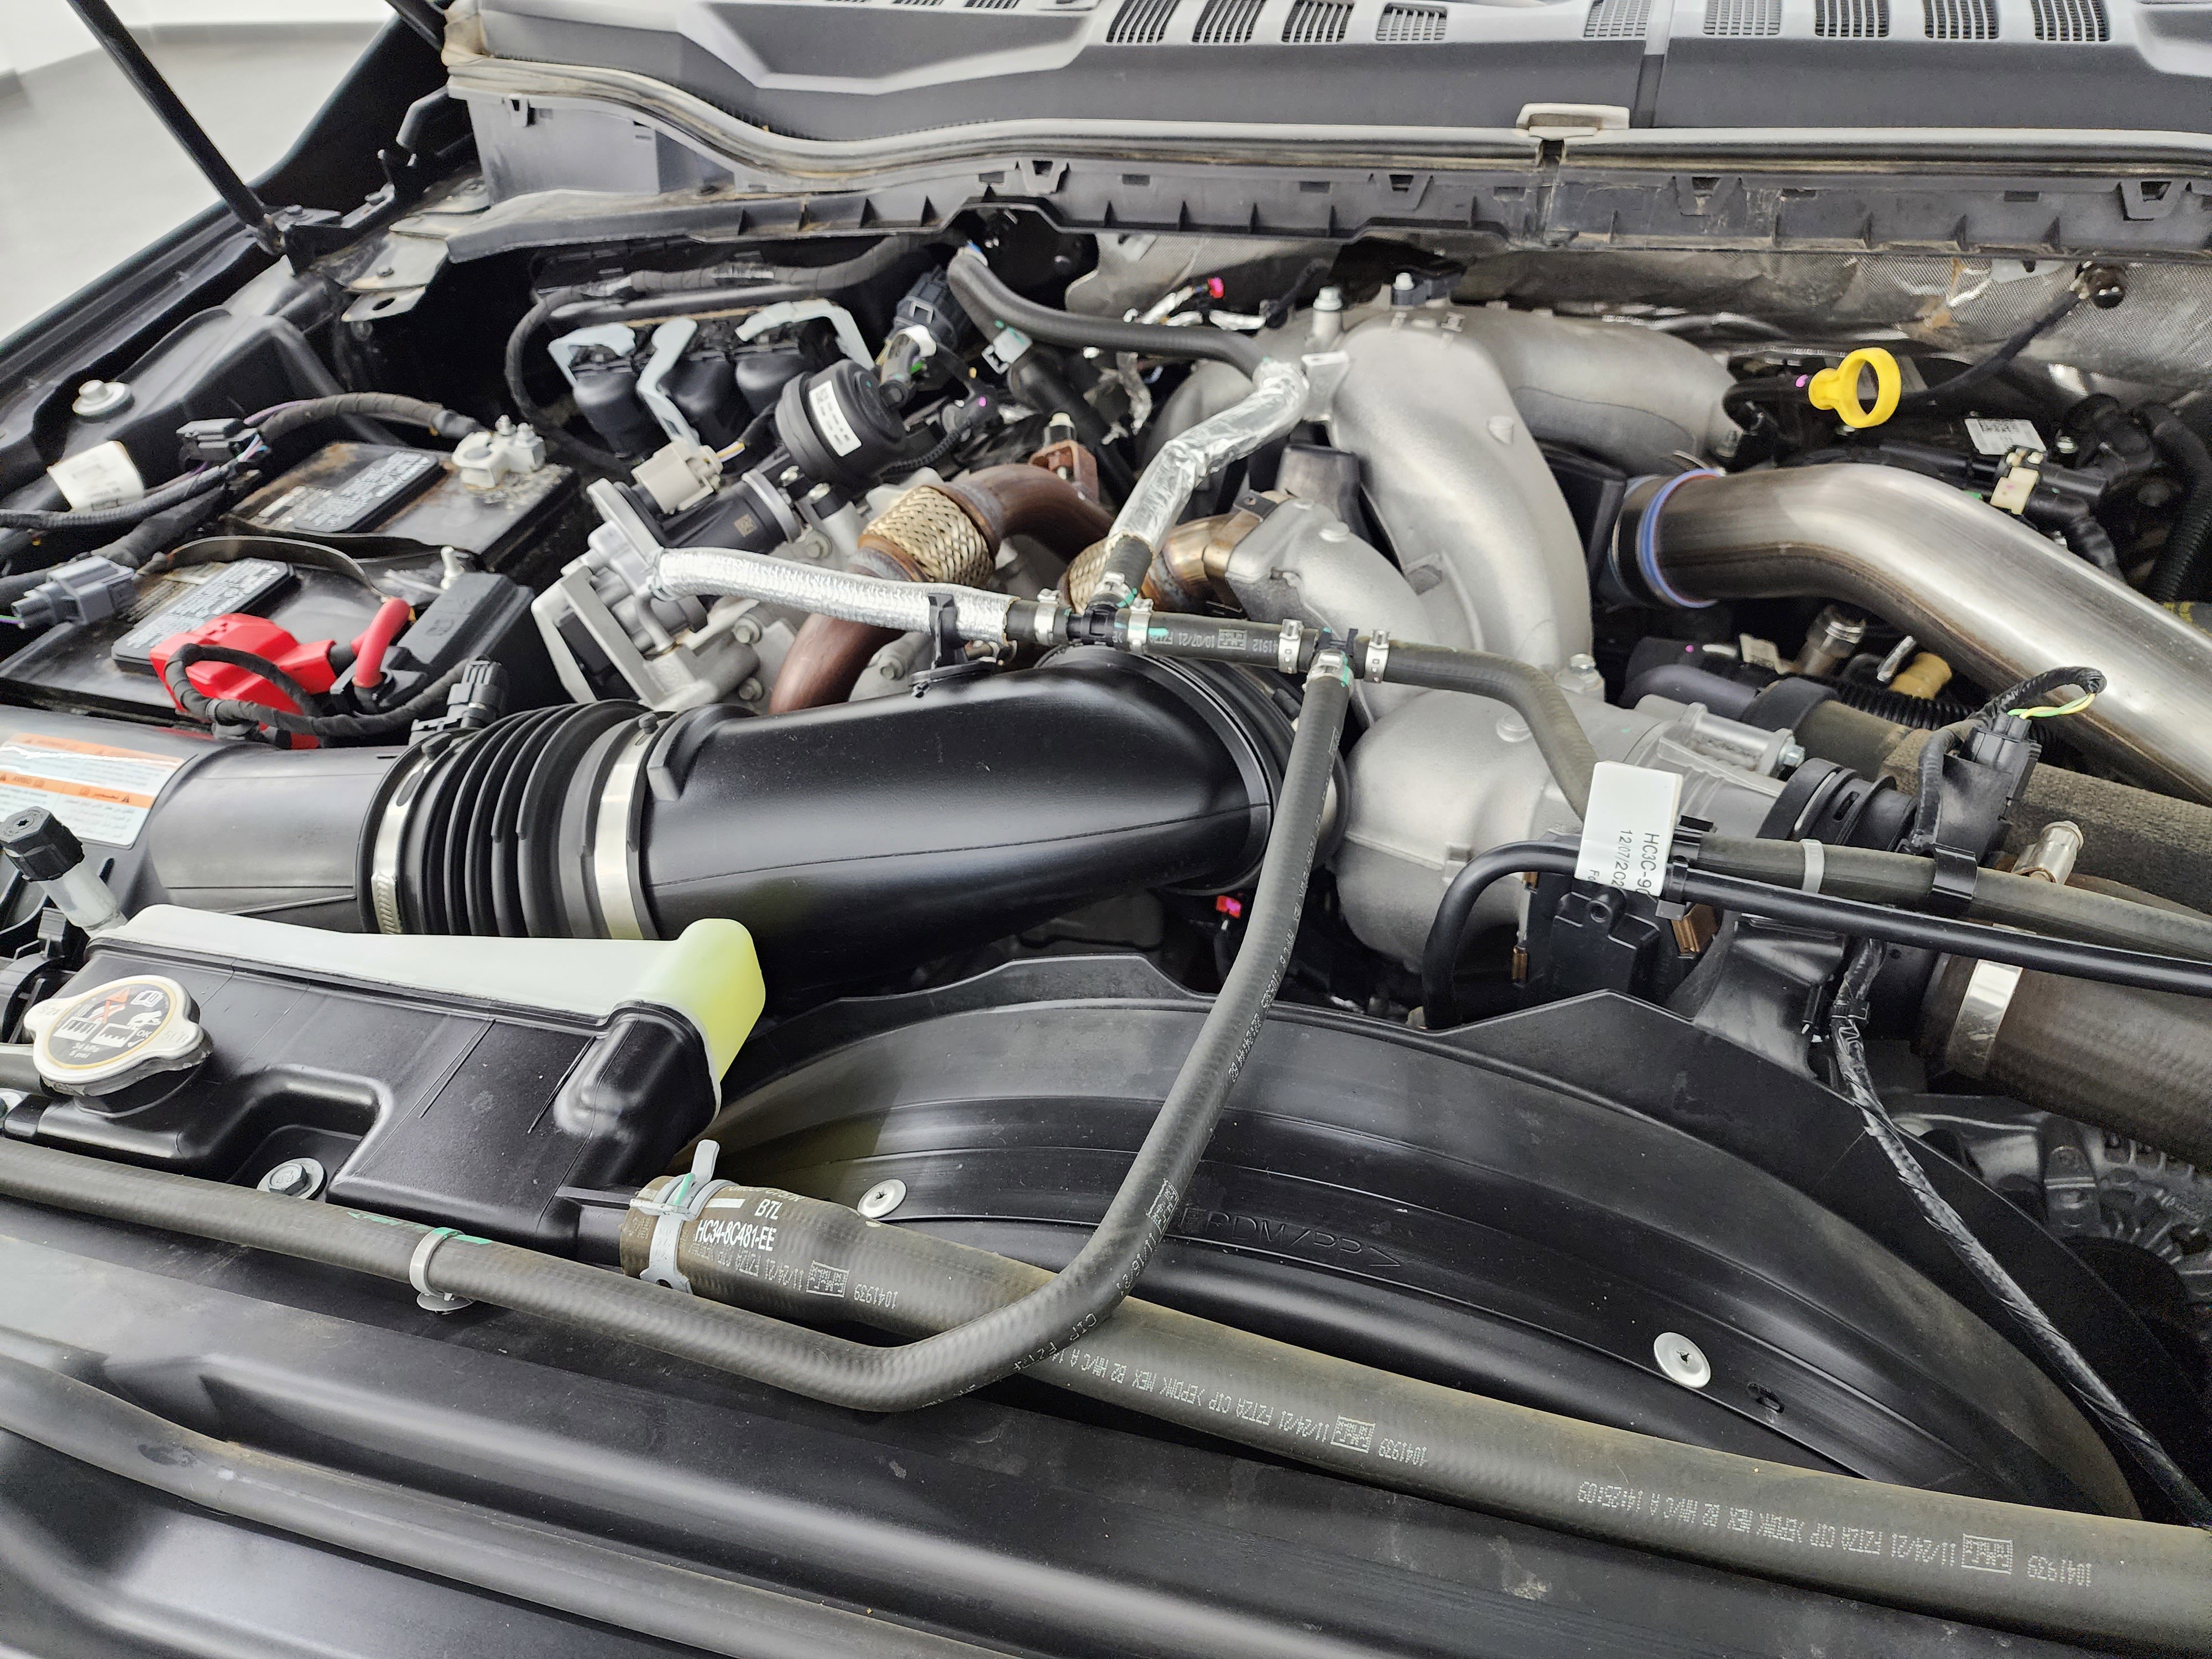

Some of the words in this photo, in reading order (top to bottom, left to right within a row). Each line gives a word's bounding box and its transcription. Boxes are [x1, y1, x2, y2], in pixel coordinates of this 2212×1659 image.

[1178, 633, 1215, 648] 10/07/21
[754, 1198, 784, 1220] BTL
[695, 1219, 777, 1251] HC34-8C481-EE
[764, 1258, 804, 1291] 11/24/21
[854, 1284, 899, 1310] 1041939
[1071, 1348, 1080, 1367] A
[1110, 1363, 1128, 1384] B2
[1208, 1390, 1232, 1414] CIP
[1278, 1411, 1330, 1442] 11/24/21
[1378, 1438, 1427, 1467] 1041939
[1578, 1480, 1644, 1512] 14:25:09
[1650, 1493, 1660, 1516] A
[1703, 1503, 1720, 1528] B2
[1809, 1522, 1835, 1548] CIP
[1890, 1533, 1957, 1568] 11/24/21
[2027, 1554, 2092, 1587] 1041939
